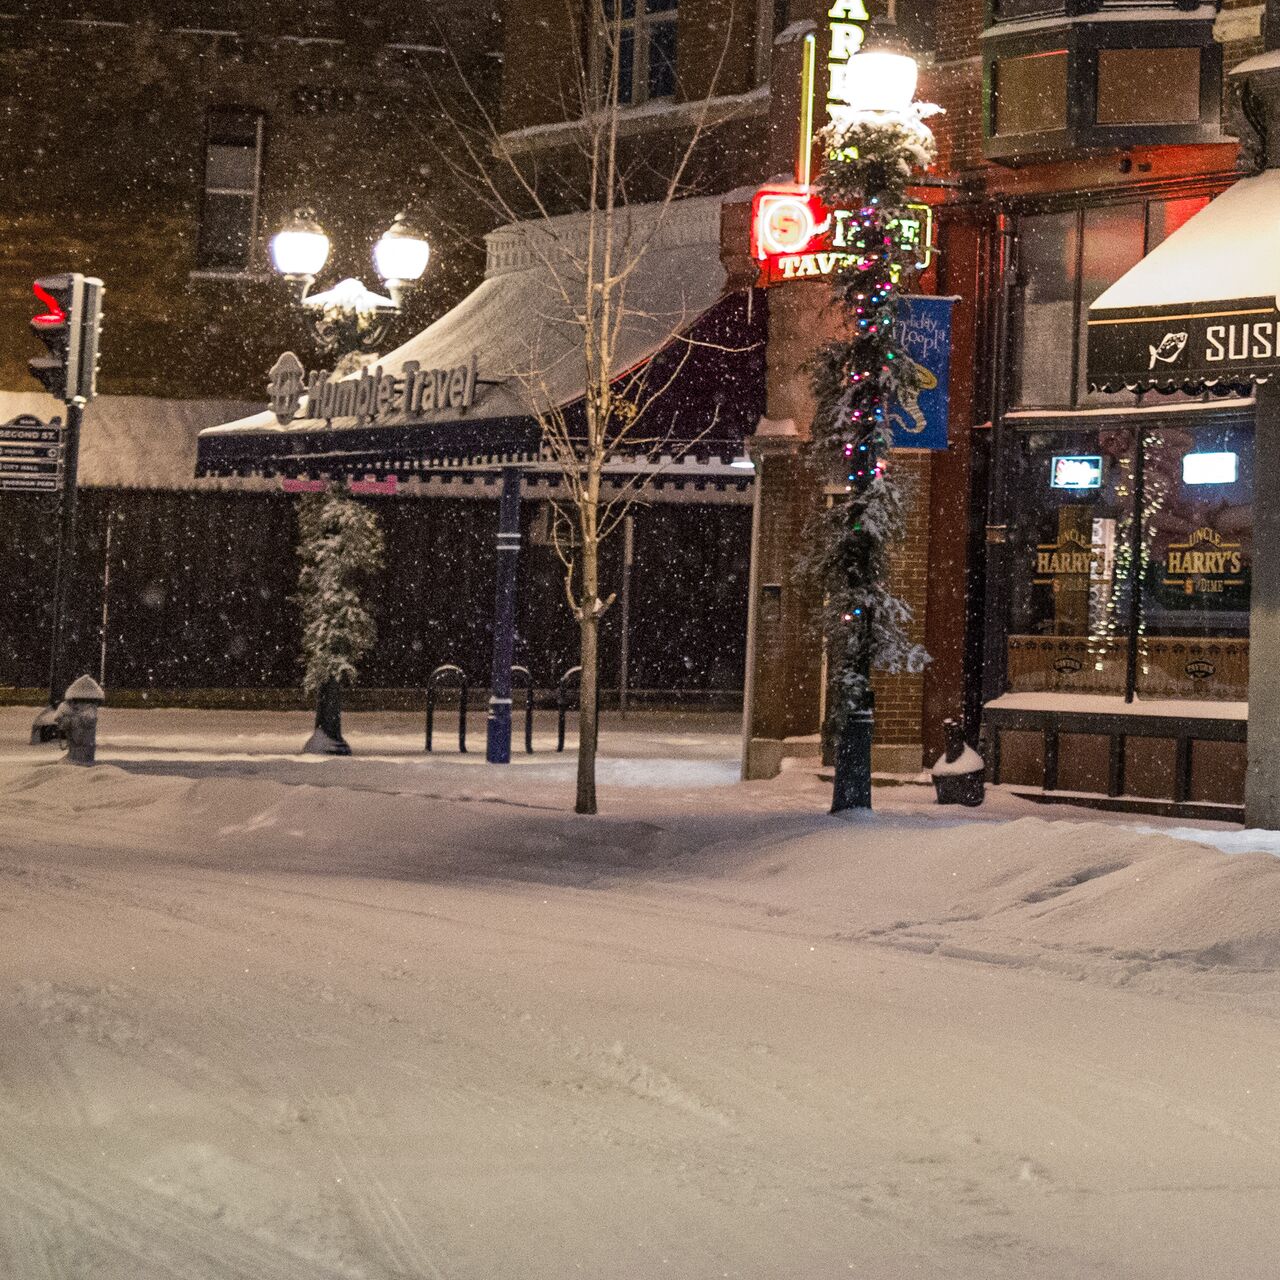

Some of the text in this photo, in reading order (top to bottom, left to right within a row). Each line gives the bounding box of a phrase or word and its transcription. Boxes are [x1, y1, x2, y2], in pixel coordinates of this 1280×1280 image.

[307, 355, 478, 419] Humble Travel
[1189, 527, 1222, 546] UNCLE
[1037, 551, 1106, 574] HARRY'S
[1167, 551, 1241, 574] HARRY'S
